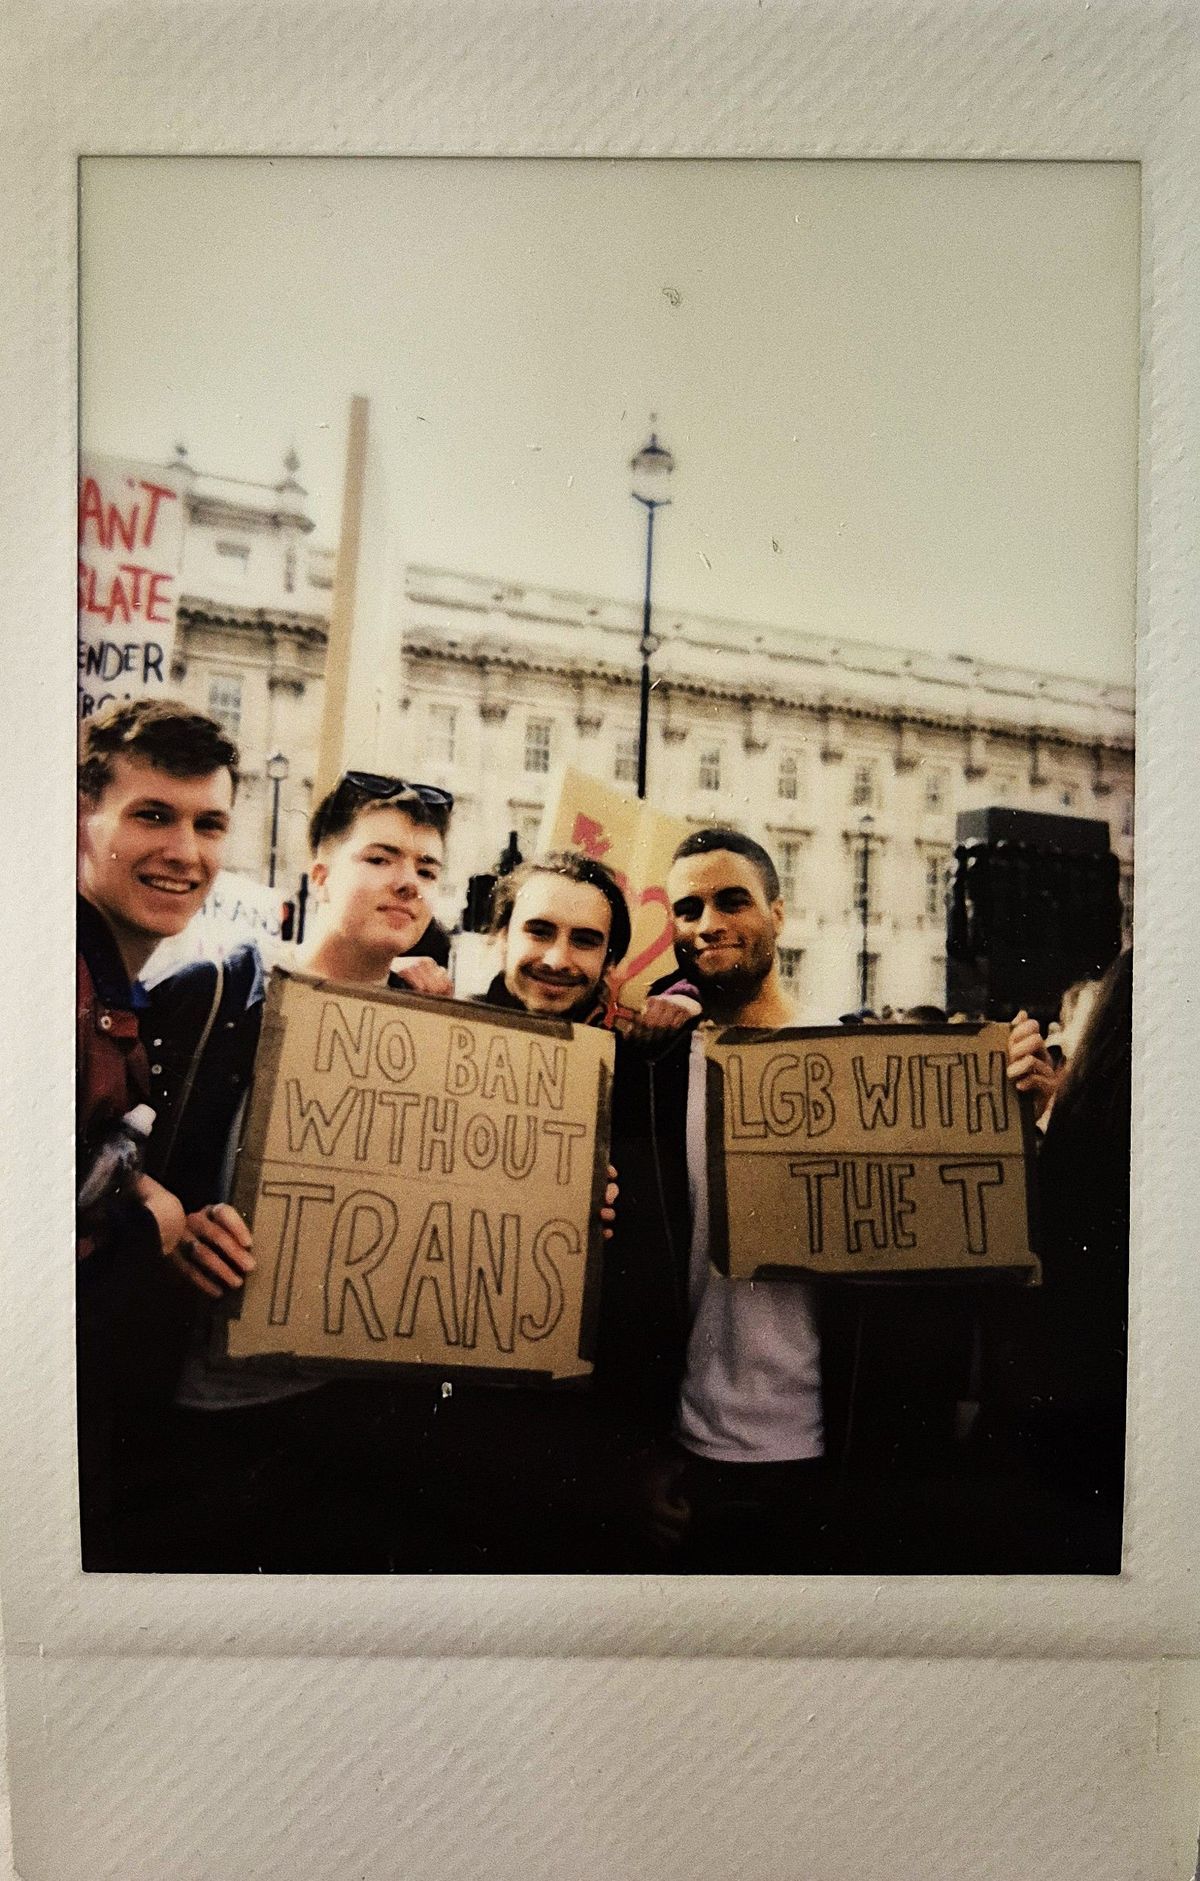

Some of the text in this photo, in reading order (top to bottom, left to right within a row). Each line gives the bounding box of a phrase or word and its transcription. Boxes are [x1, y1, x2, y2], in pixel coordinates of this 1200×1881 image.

[315, 1000, 568, 1111] NO BAN
[727, 1050, 1011, 1140] LGB WITH
[286, 1077, 586, 1186] WITHOUT
[790, 1159, 1004, 1256] THE T
[262, 1180, 582, 1353] TRANS
